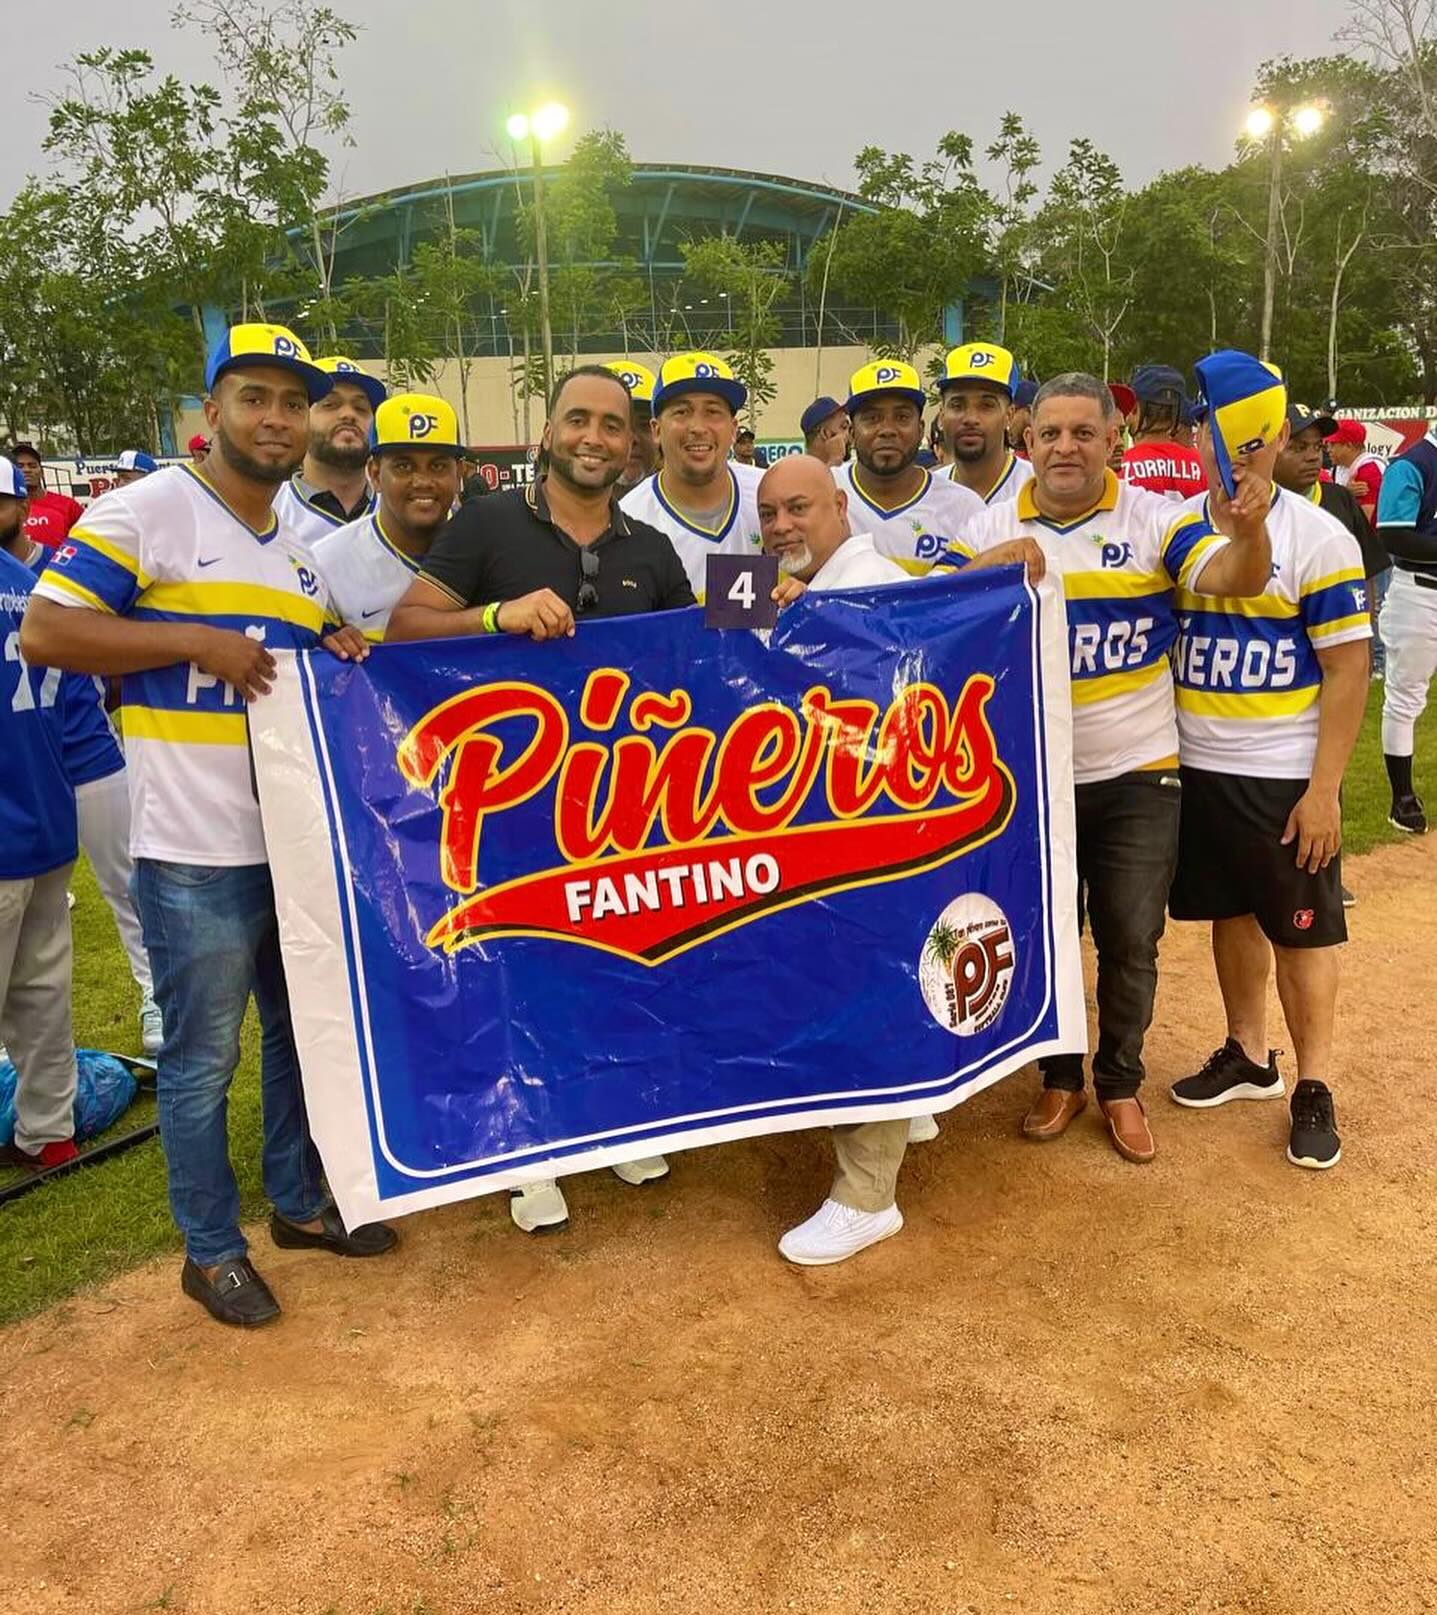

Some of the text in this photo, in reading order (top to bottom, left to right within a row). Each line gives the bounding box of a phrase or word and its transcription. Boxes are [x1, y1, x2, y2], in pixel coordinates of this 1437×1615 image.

[410, 414, 438, 439] PF
[1367, 442, 1392, 457] logy
[1121, 459, 1200, 481] ZORRILLA
[27, 516, 49, 527] on
[728, 571, 756, 609] 4
[1072, 617, 1154, 674] ROS
[396, 668, 998, 894] Piñeros
[564, 853, 780, 922] FANTINO
